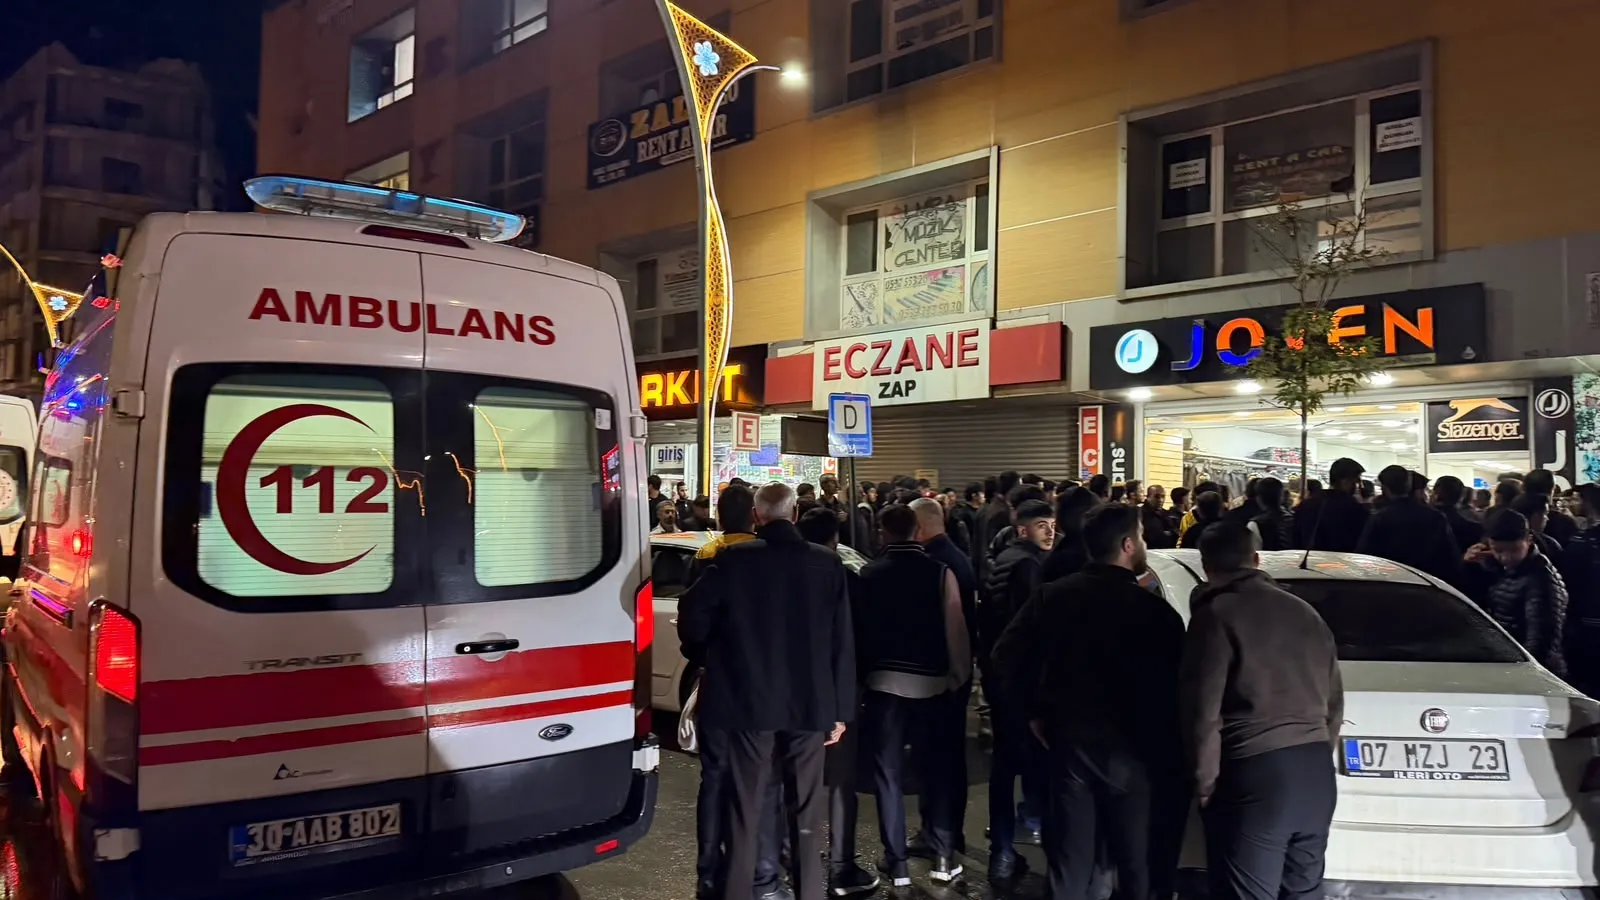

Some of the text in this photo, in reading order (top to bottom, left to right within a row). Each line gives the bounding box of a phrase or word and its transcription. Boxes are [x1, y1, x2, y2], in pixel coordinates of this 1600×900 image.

[637, 134, 678, 163] RENT
[1232, 156, 1281, 172] RENT
[1306, 145, 1345, 158] CAR
[248, 287, 556, 346] AMBULANS
[1170, 302, 1434, 372] JOEN
[823, 328, 980, 381] ECZANE
[878, 379, 917, 399] ZAP
[843, 404, 858, 430] D
[742, 420, 753, 443] E
[1436, 421, 1521, 441] Slazenger
[259, 465, 389, 514] 112
[242, 652, 363, 671] TRANSIT
[1360, 742, 1500, 770] 07 MZJ 23
[1433, 772, 1462, 780] OTO
[246, 808, 396, 855] 30 AAB 802
